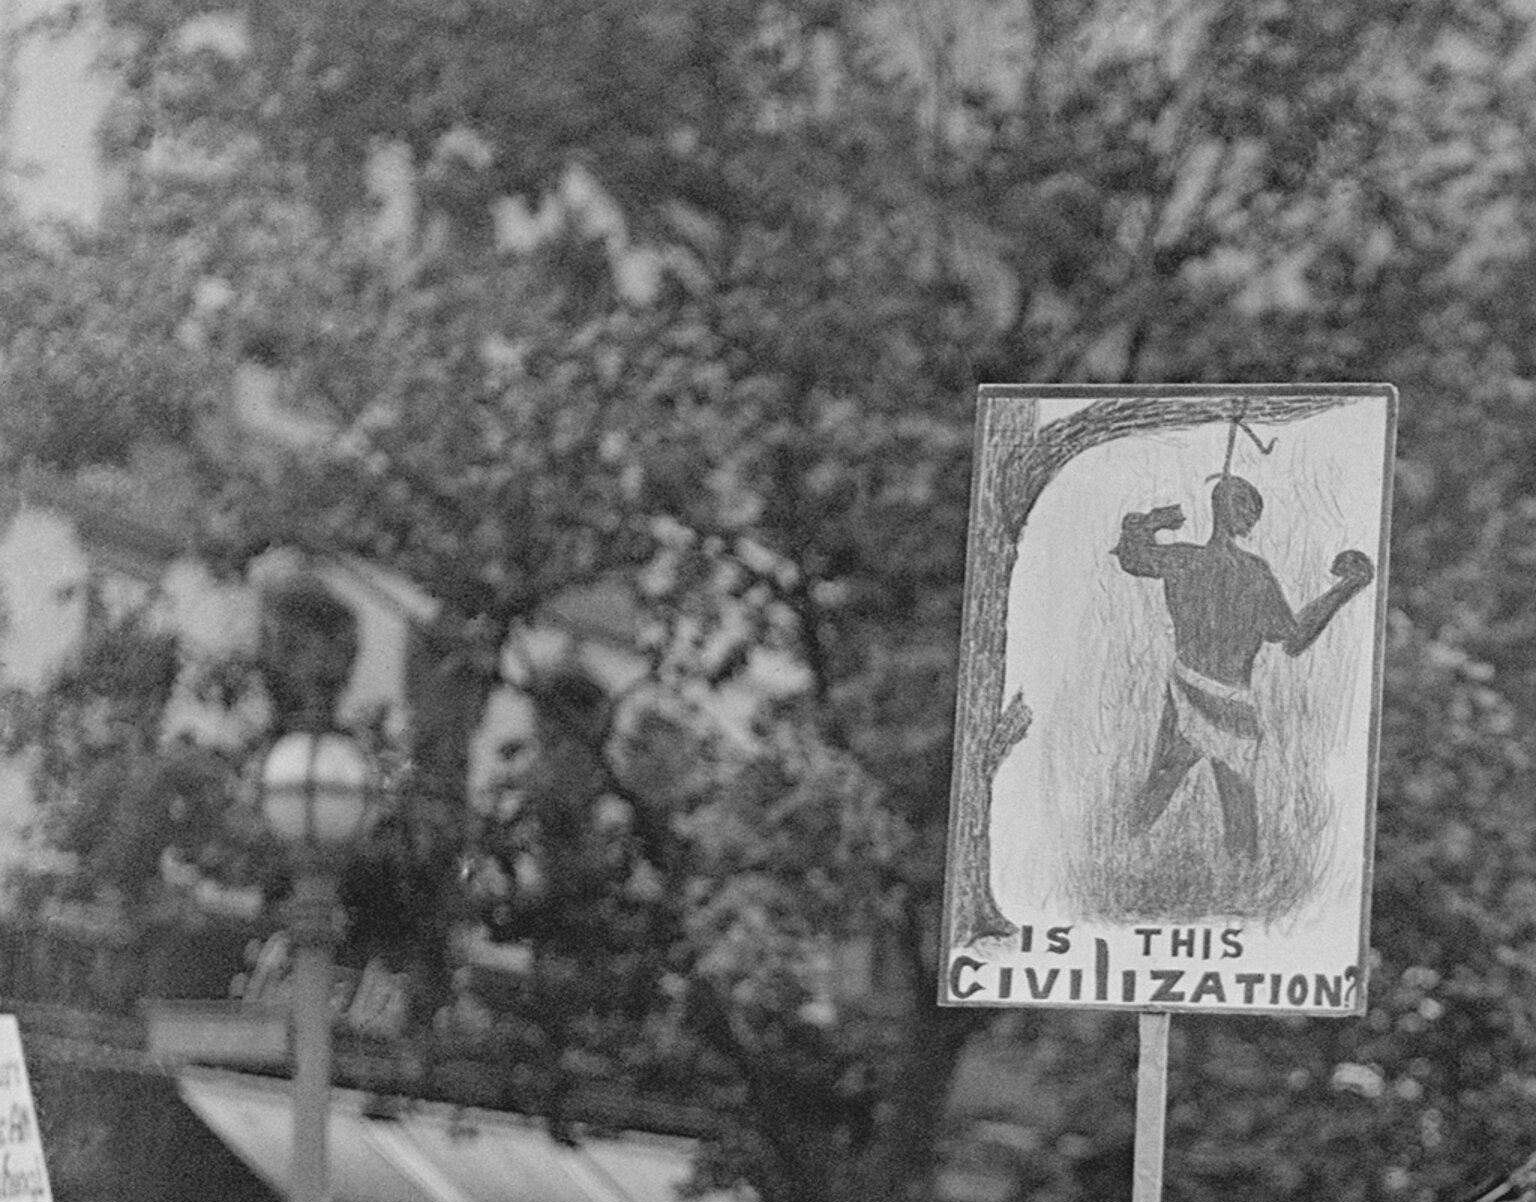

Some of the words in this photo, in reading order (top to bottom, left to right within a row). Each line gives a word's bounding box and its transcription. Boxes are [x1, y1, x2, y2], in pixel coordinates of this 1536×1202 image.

[1021, 925, 1074, 955] IS
[1134, 928, 1244, 960] THIS
[950, 937, 1362, 1009] CIVILIZATION?
